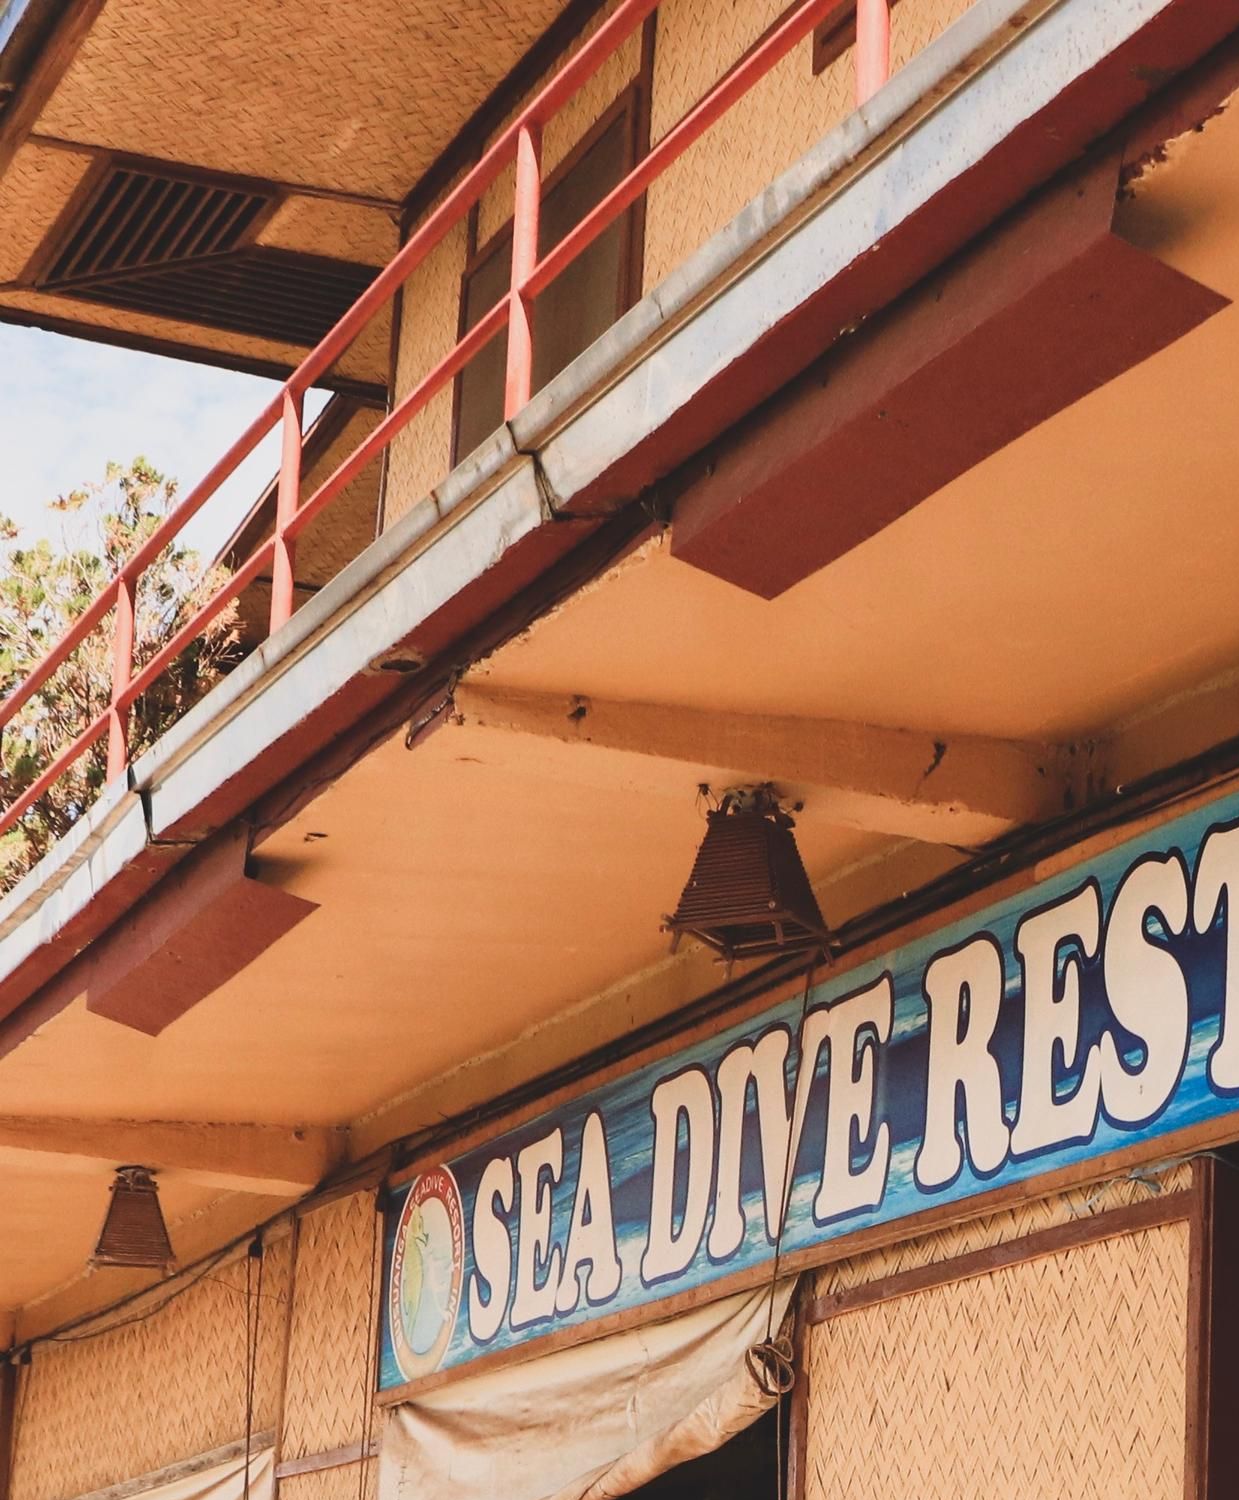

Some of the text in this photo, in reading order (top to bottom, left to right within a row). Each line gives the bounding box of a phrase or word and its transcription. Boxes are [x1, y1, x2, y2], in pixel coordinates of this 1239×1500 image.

[445, 1186, 462, 1270] RESORT
[469, 1112, 622, 1345] SEA
[640, 970, 895, 1266] DIVE
